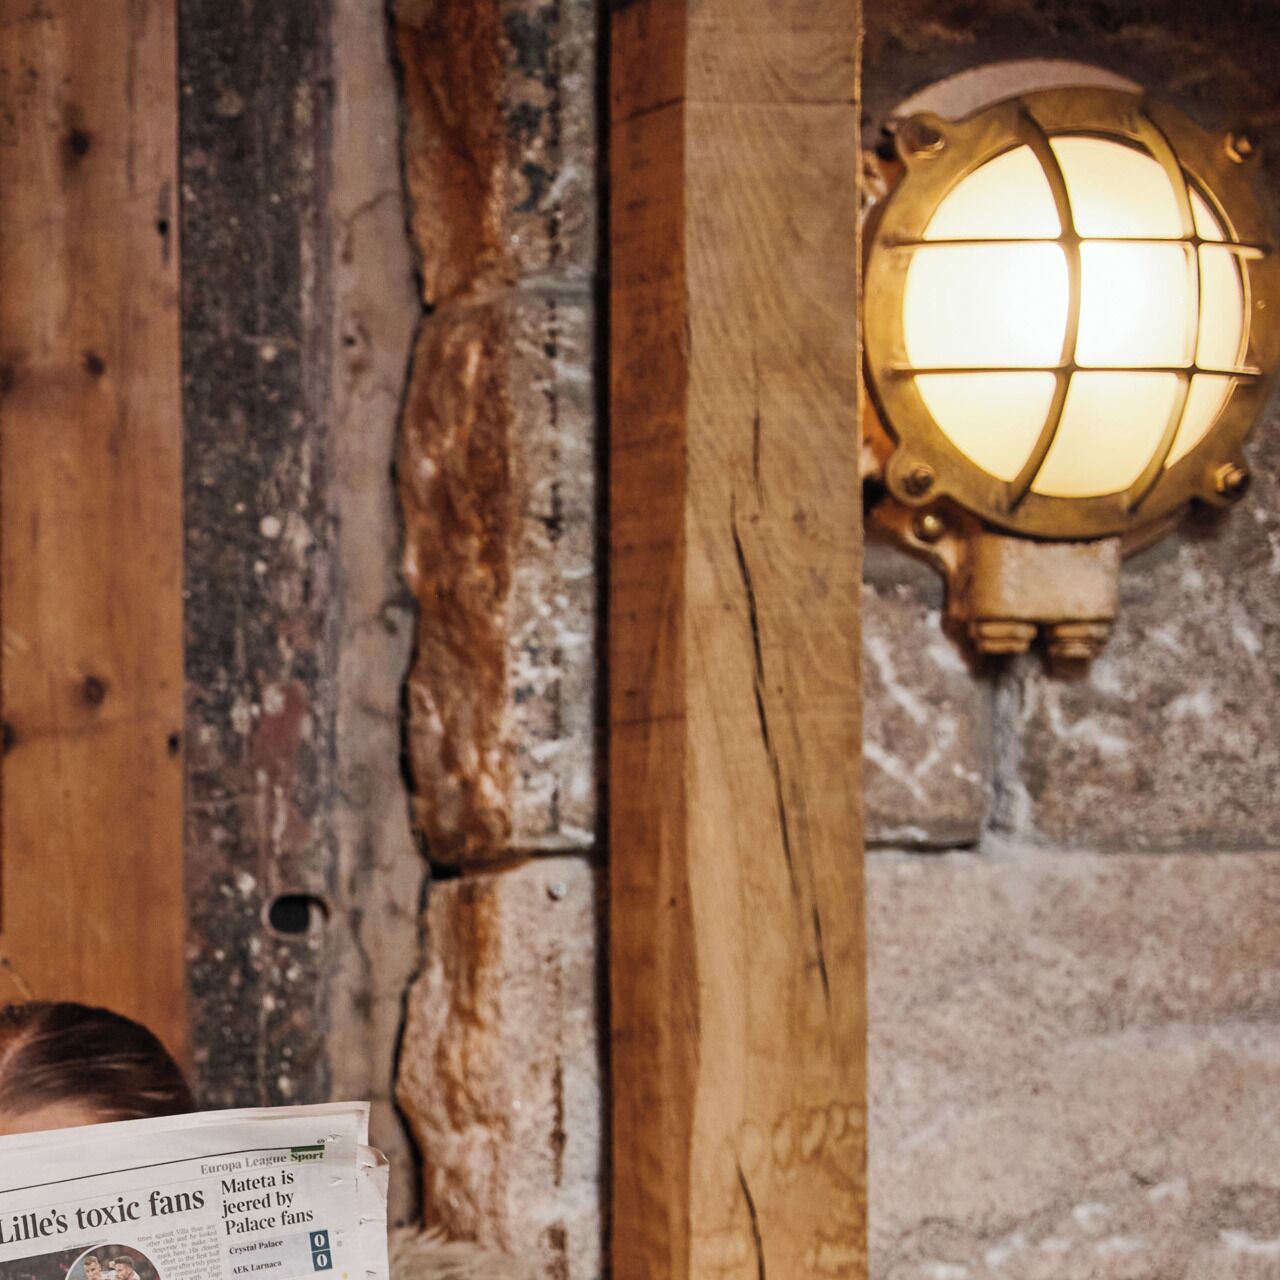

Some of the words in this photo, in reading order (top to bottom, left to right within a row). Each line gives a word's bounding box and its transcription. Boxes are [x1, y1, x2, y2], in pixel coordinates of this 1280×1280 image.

[200, 1160, 242, 1176] Europa
[245, 1154, 287, 1170] League
[290, 1151, 325, 1163] Sport
[221, 1176, 276, 1195] Mateta
[281, 1170, 294, 1185] is
[75, 1196, 142, 1231] toxic
[148, 1189, 205, 1217] fans
[221, 1193, 271, 1218] jeered
[276, 1191, 294, 1208] by
[224, 1214, 276, 1235] Palace
[281, 1209, 314, 1226] fans
[229, 1243, 257, 1255] Crystal
[258, 1240, 284, 1250] Palace
[314, 1233, 325, 1247] 0
[232, 1264, 249, 1275] AEK
[251, 1260, 282, 1272] Larnaca
[316, 1253, 328, 1267] 0
